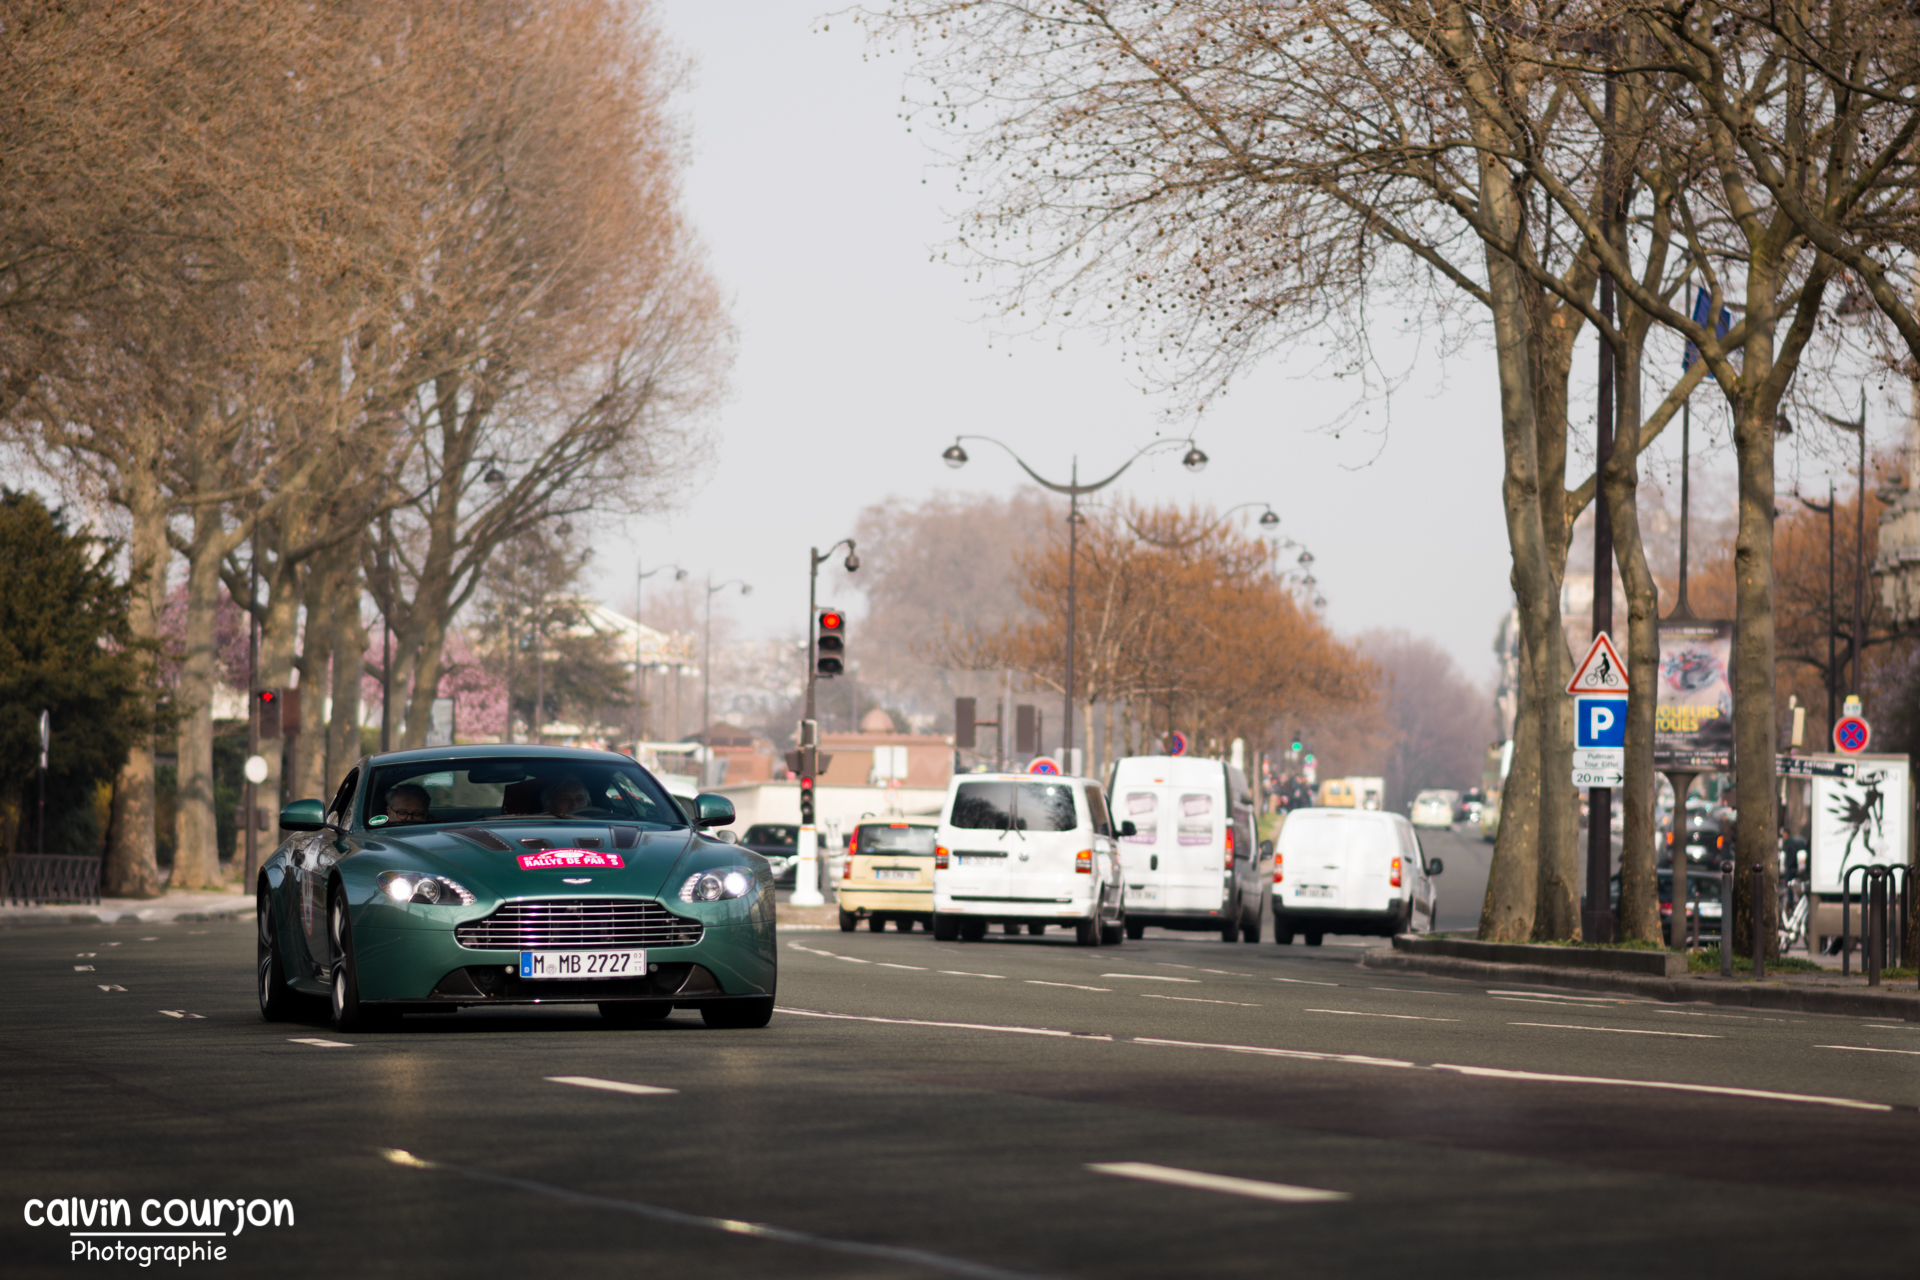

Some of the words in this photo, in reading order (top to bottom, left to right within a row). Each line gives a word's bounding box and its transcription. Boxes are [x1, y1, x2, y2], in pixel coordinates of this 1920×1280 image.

[1591, 707, 1614, 739] P
[1577, 774, 1591, 782] 20
[525, 857, 563, 867] RALLYE
[534, 955, 544, 973] M
[559, 955, 581, 973] MB
[587, 954, 630, 973] 2727
